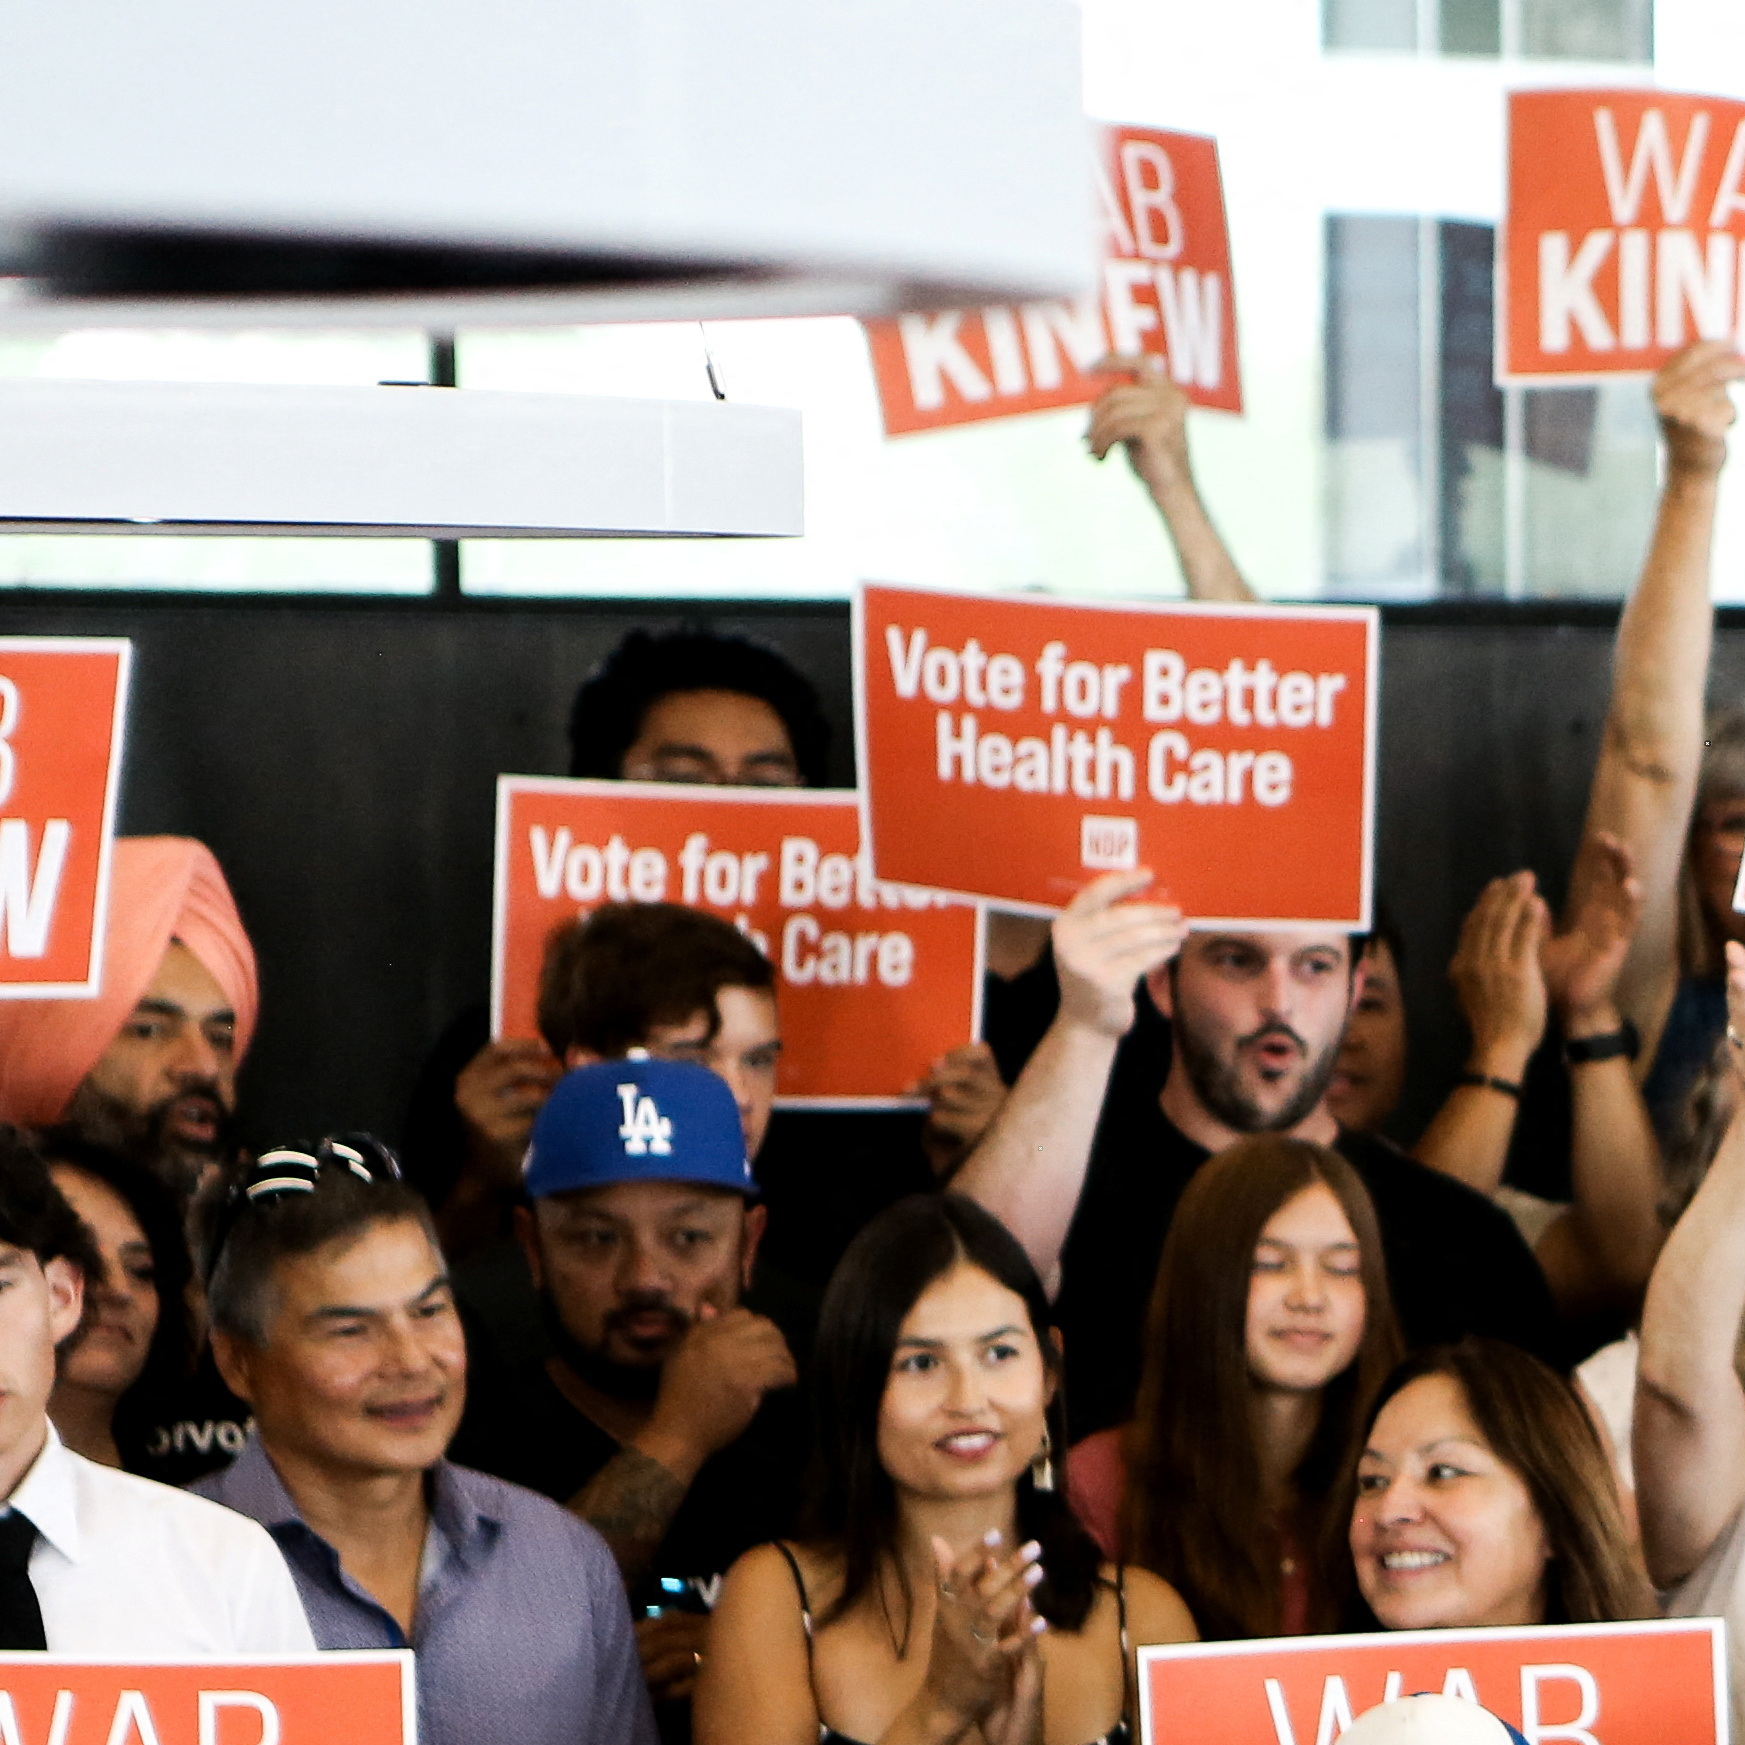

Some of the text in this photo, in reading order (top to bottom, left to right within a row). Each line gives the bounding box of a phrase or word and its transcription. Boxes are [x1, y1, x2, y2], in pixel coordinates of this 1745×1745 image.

[886, 626, 1346, 728] Vote for Better
[937, 712, 1293, 807] Health Care
[530, 826, 667, 903] Vote
[679, 834, 769, 906] for
[783, 916, 914, 987] Care
[617, 1083, 672, 1155] LA
